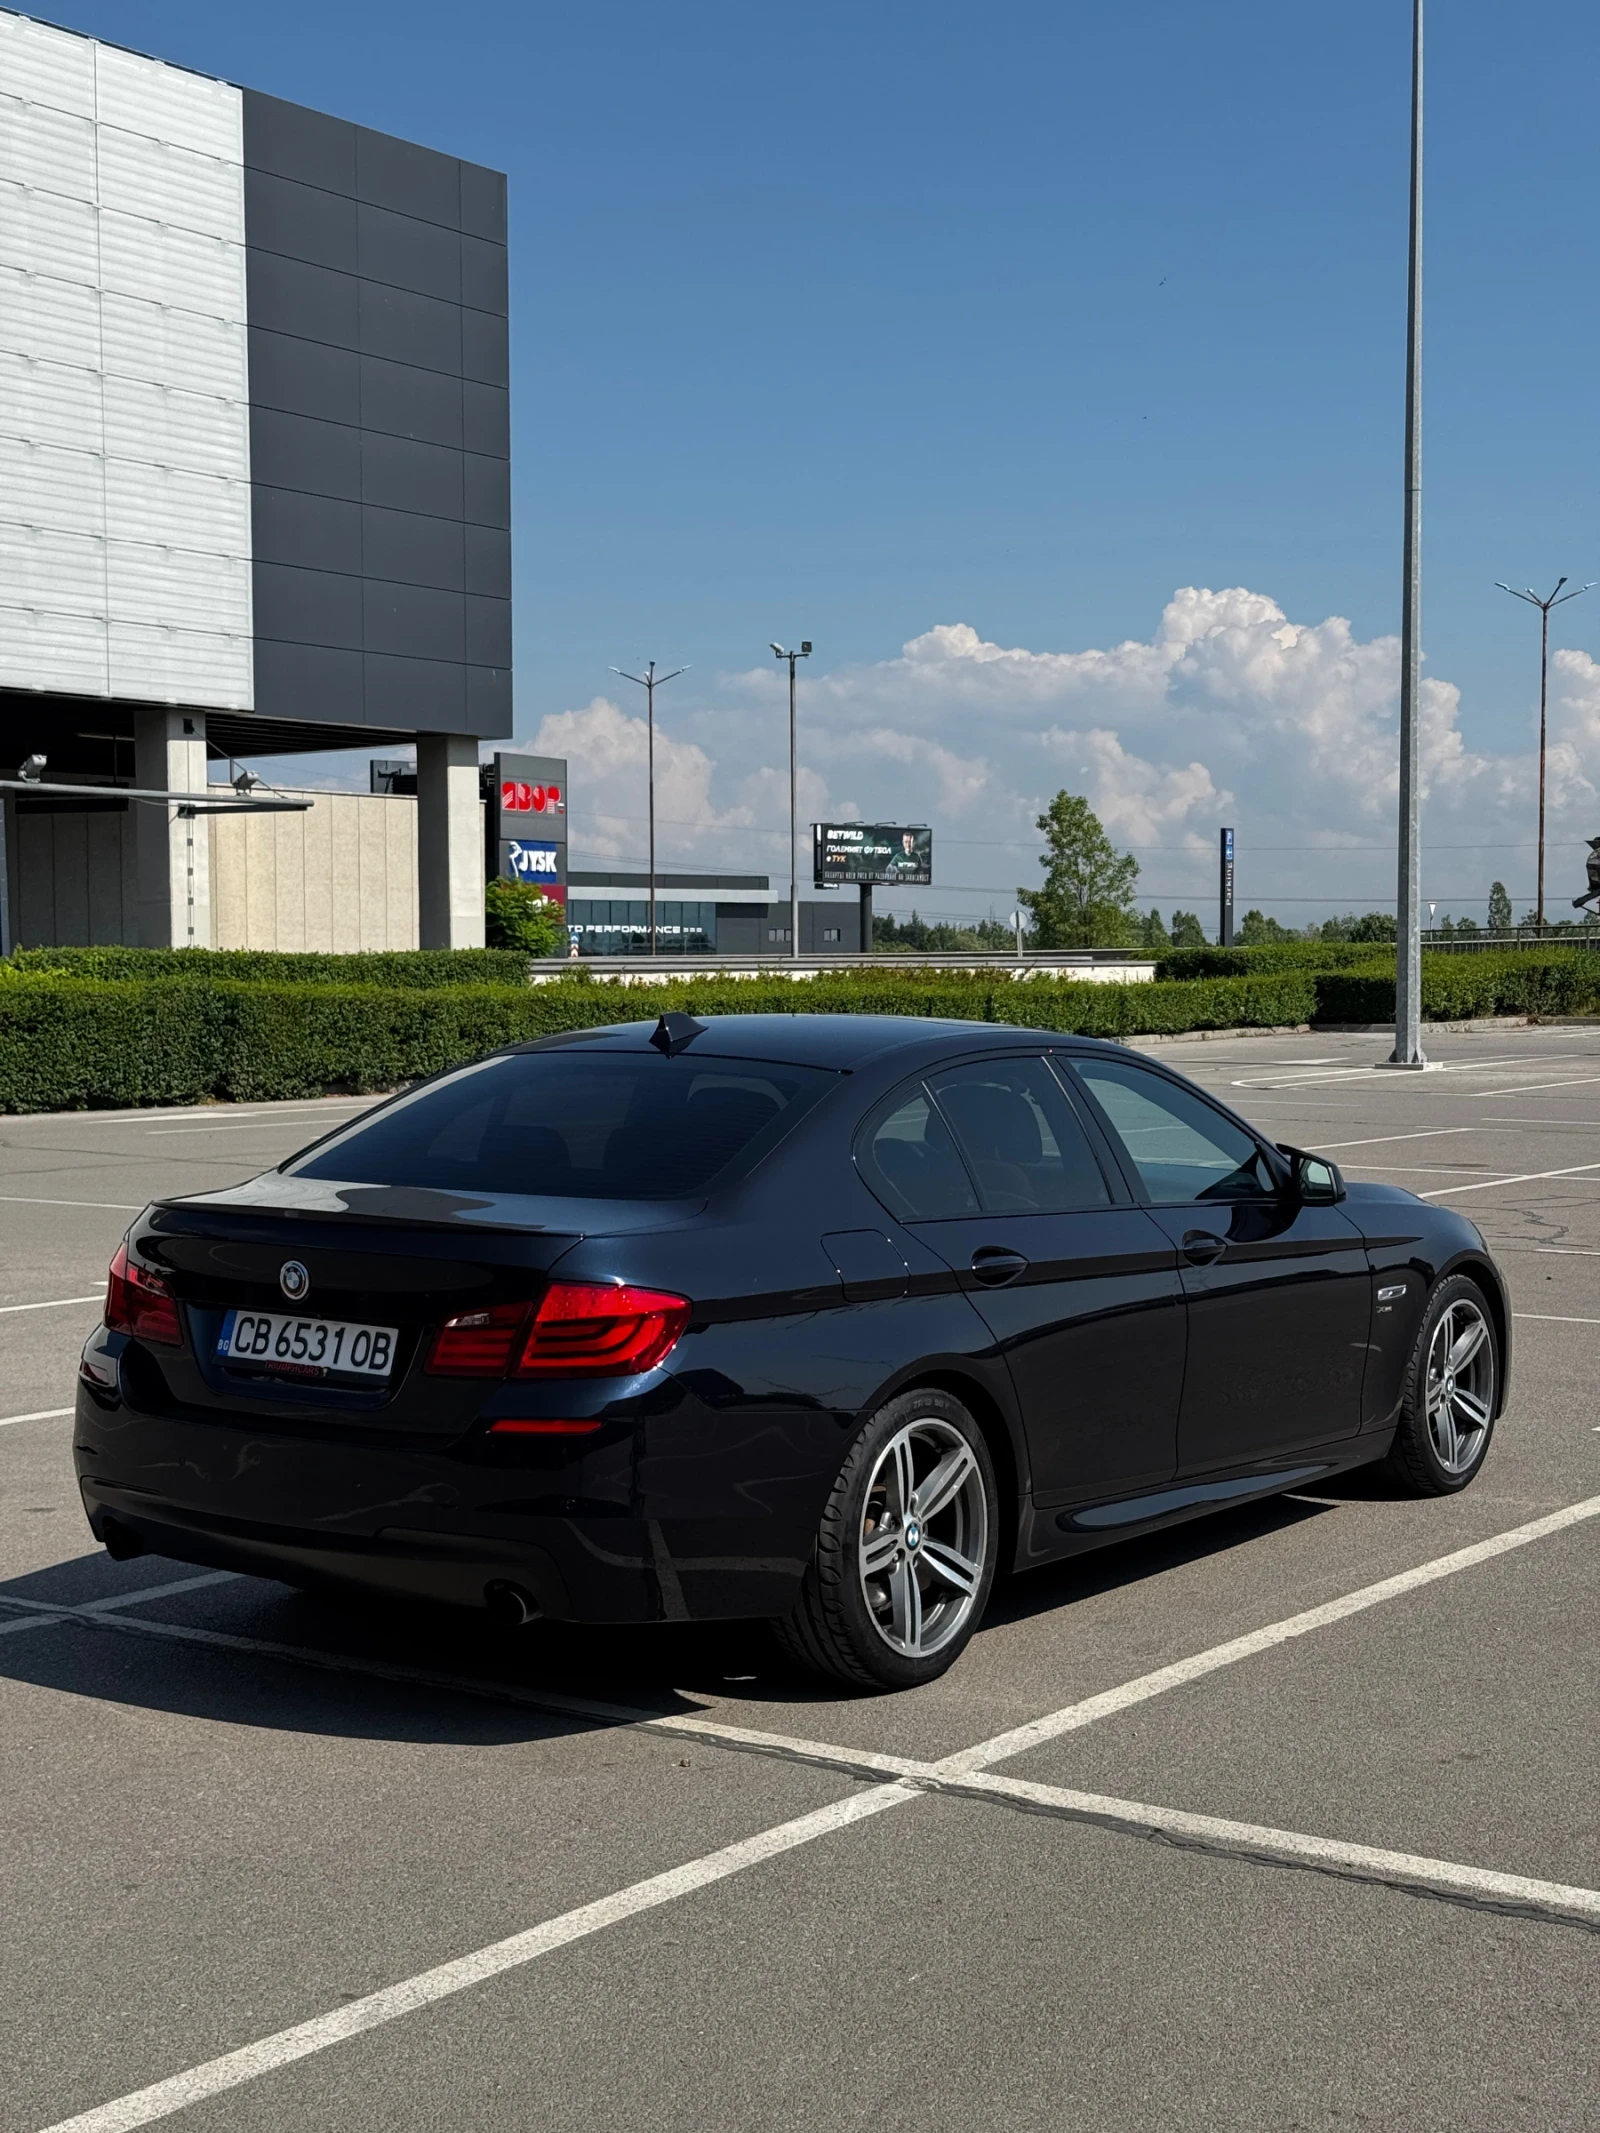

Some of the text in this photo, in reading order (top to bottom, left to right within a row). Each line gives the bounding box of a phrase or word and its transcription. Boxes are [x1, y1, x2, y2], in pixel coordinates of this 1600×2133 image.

[827, 830, 863, 840] BETWILD
[519, 850, 557, 872] JYSK
[567, 925, 583, 933] TO
[217, 1339, 229, 1351] BG
[234, 1317, 272, 1355] CB
[275, 1321, 346, 1365] 6531
